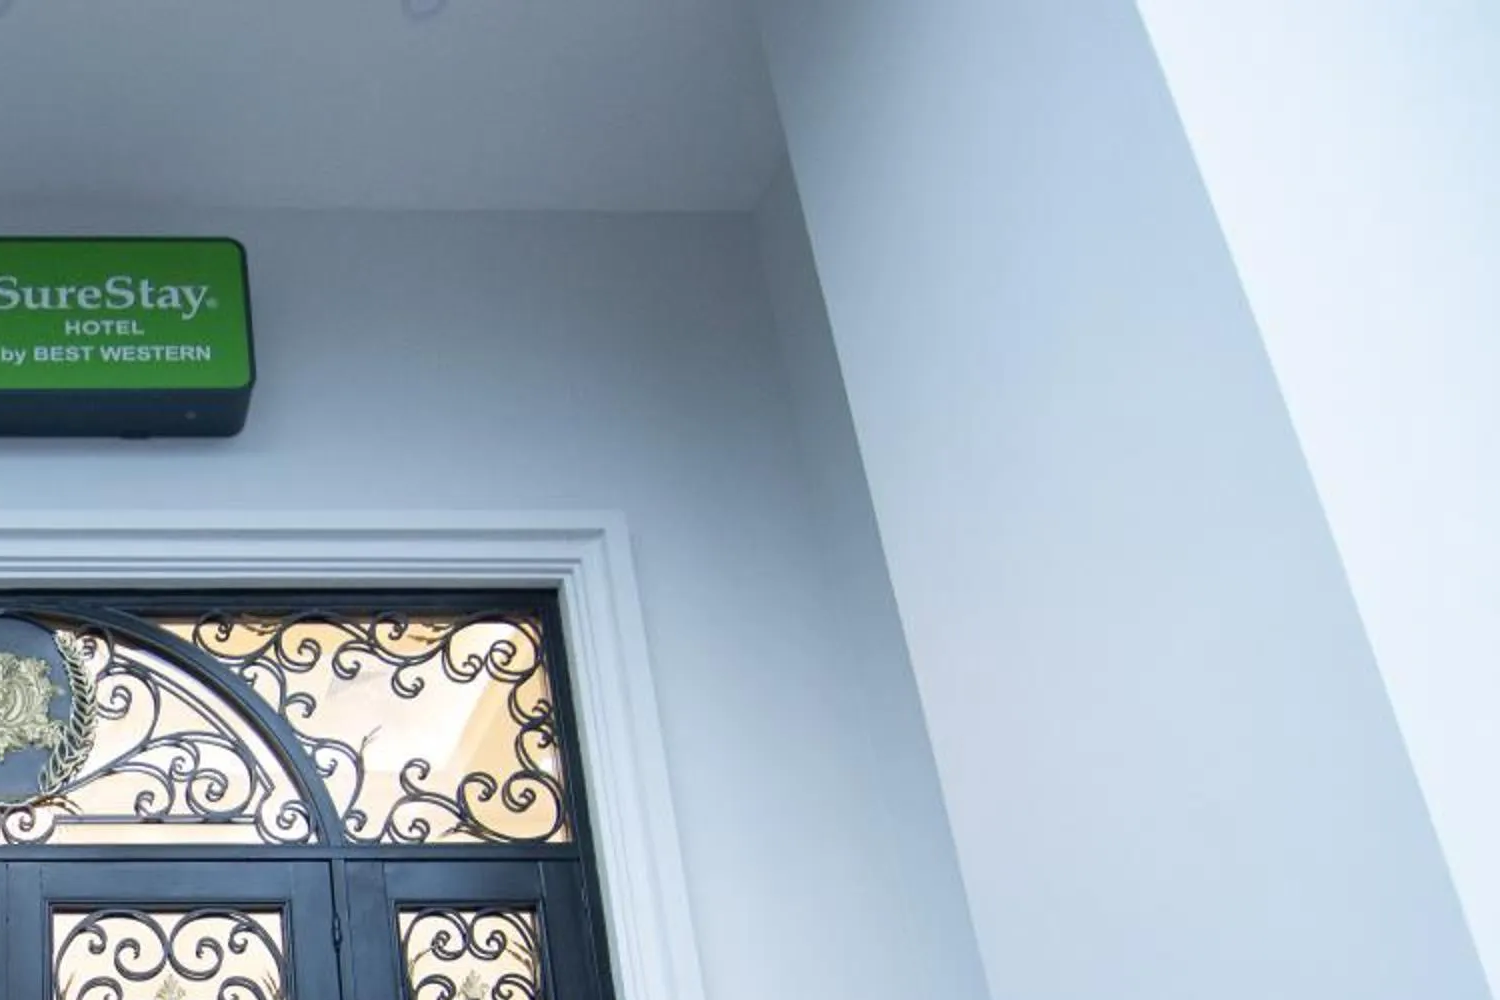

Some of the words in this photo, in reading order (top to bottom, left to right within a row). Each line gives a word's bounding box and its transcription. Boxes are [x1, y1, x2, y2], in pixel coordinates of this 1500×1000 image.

[64, 319, 145, 336] HOTEL
[1, 347, 26, 365] by
[33, 346, 94, 362] BEST
[100, 345, 212, 362] WESTERN
